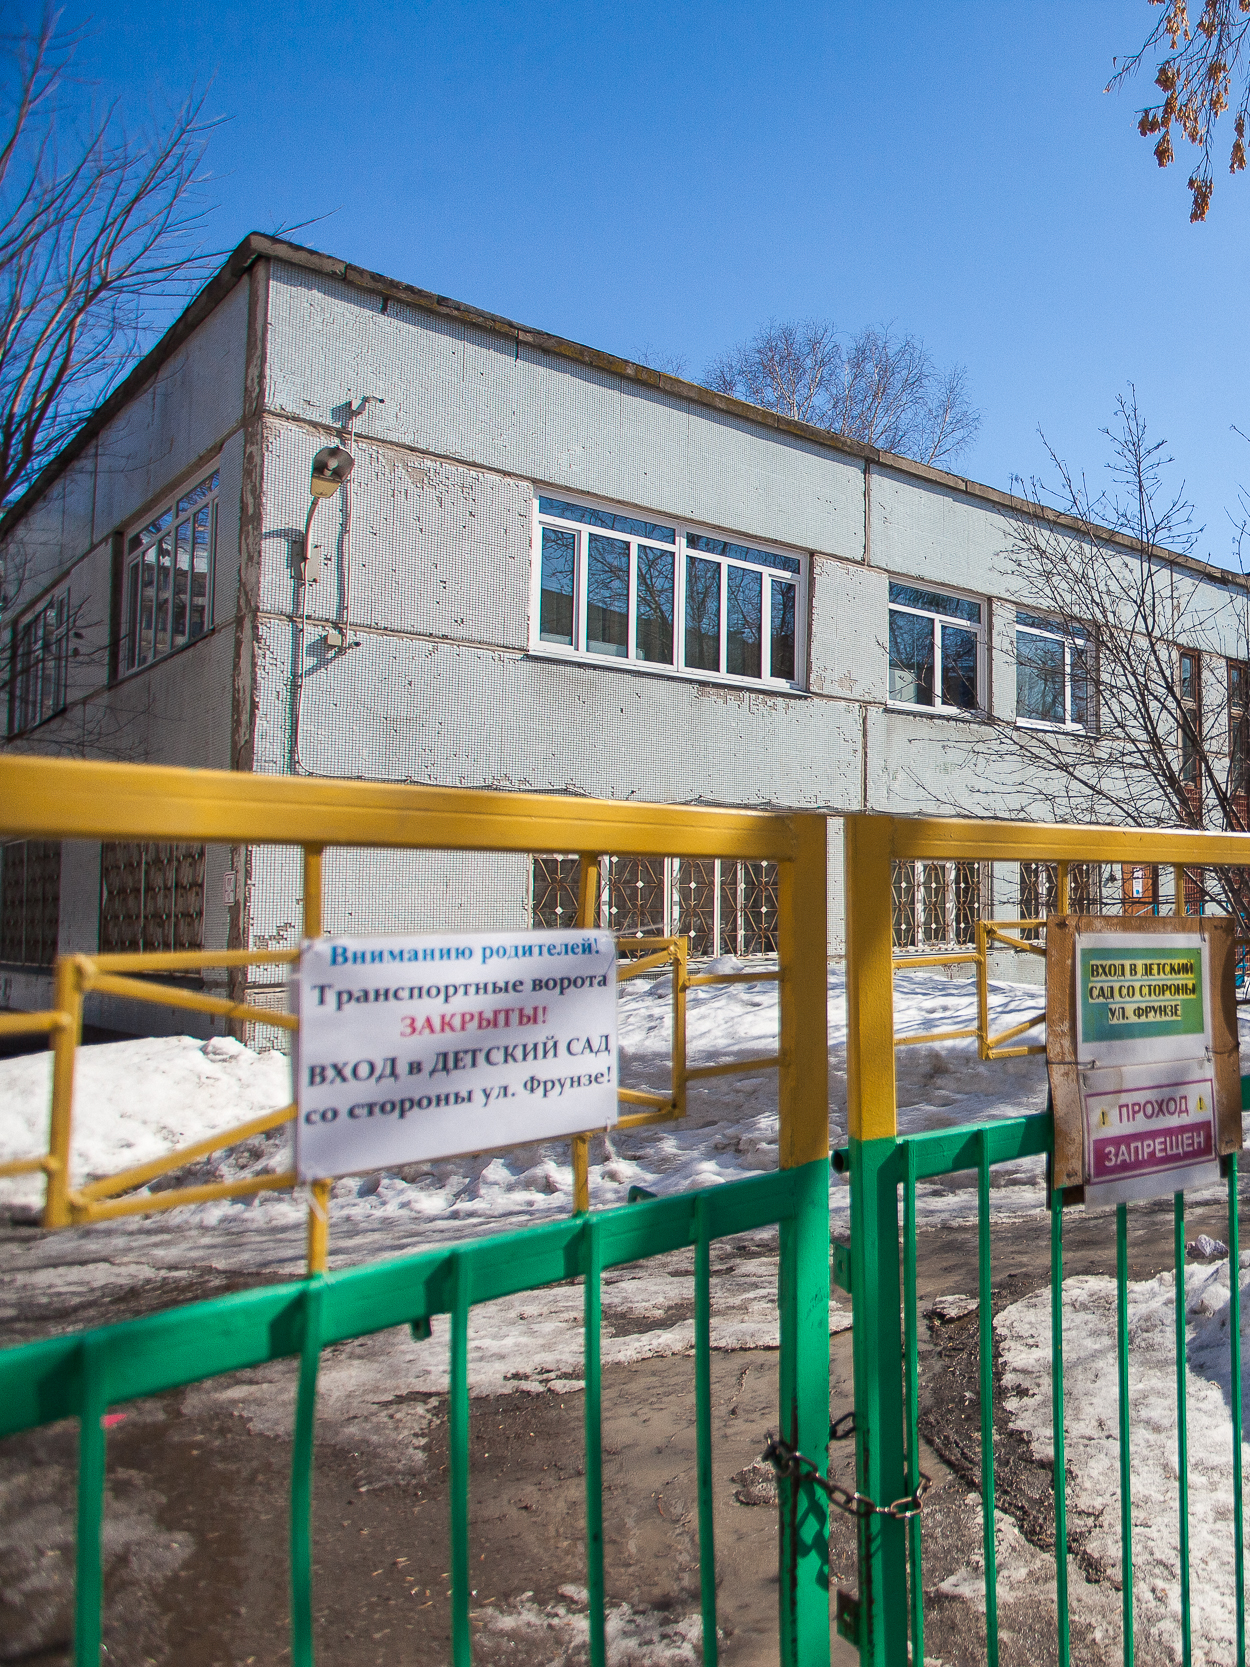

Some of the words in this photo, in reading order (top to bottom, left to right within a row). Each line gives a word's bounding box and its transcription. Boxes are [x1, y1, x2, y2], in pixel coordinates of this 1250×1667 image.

[329, 945, 473, 967] Вниманию
[481, 938, 600, 963] родителей!
[1090, 962, 1126, 979] ВХОД
[1129, 962, 1138, 977] В
[1140, 959, 1194, 977] ДЕТСКИЙ
[311, 976, 523, 1011] Транспортные
[530, 973, 608, 997] ворота
[1089, 984, 1114, 1001] САД
[1118, 983, 1135, 999] СО
[1139, 980, 1196, 998] СТОРОНЫ
[400, 1005, 547, 1037] ЗАКРЫТЫ!
[1108, 1006, 1129, 1021] УЛ.
[1133, 1003, 1181, 1020] ФРУНЗЕ
[307, 1057, 398, 1087] ВХОД
[407, 1060, 422, 1076] в
[428, 1036, 558, 1077] ДЕТСКИЙ
[566, 1034, 611, 1056] САД
[304, 1107, 338, 1125] со
[347, 1089, 473, 1119] стороны
[481, 1085, 515, 1108] ул.
[523, 1066, 612, 1098] Фрунзе!
[1118, 1095, 1189, 1124] ПРОХОД
[1104, 1131, 1204, 1167] ЗАПРЕЩЕН
